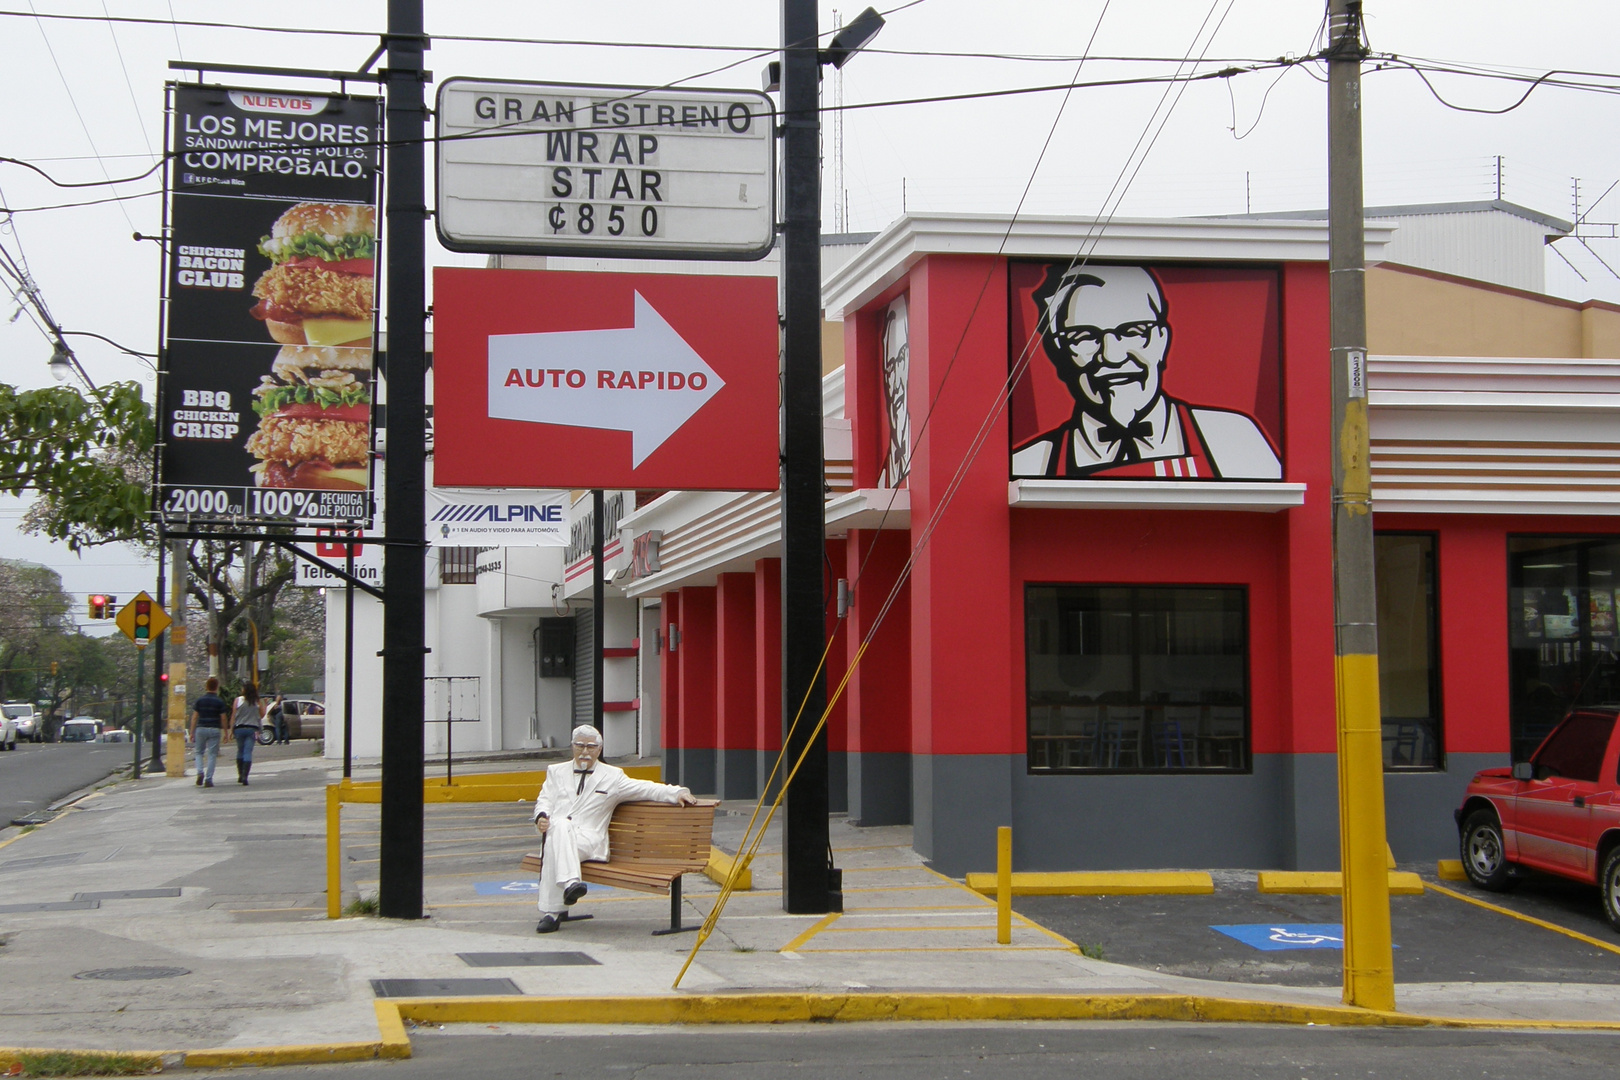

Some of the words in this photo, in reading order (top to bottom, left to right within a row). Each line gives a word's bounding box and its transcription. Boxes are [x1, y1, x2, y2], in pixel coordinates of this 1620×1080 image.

[242, 94, 312, 110] NUEVOS
[475, 96, 574, 123] GRAN
[592, 101, 751, 133] ESTRENO
[185, 113, 237, 136] LOS
[244, 117, 369, 144] MEJORES
[546, 131, 658, 165] WRAP
[184, 151, 368, 179] COMPROBALO.
[231, 178, 246, 186] Rica
[552, 166, 663, 202] STAR
[549, 202, 658, 236] ¢850
[178, 245, 246, 259] CHICKEN
[178, 255, 245, 271] BACON
[178, 269, 245, 289] CLUB
[504, 368, 586, 389] AUTO
[596, 369, 708, 391] RAPIDO
[183, 389, 231, 411] BBQ
[173, 409, 240, 423] CHICKEN
[172, 422, 239, 439] CRISP
[252, 490, 319, 517] 100%
[320, 492, 363, 506] PECHUGA
[319, 504, 333, 517] DE
[334, 505, 363, 518] POLLO
[473, 504, 563, 522] ALPINE
[302, 564, 377, 579] Teleiión
